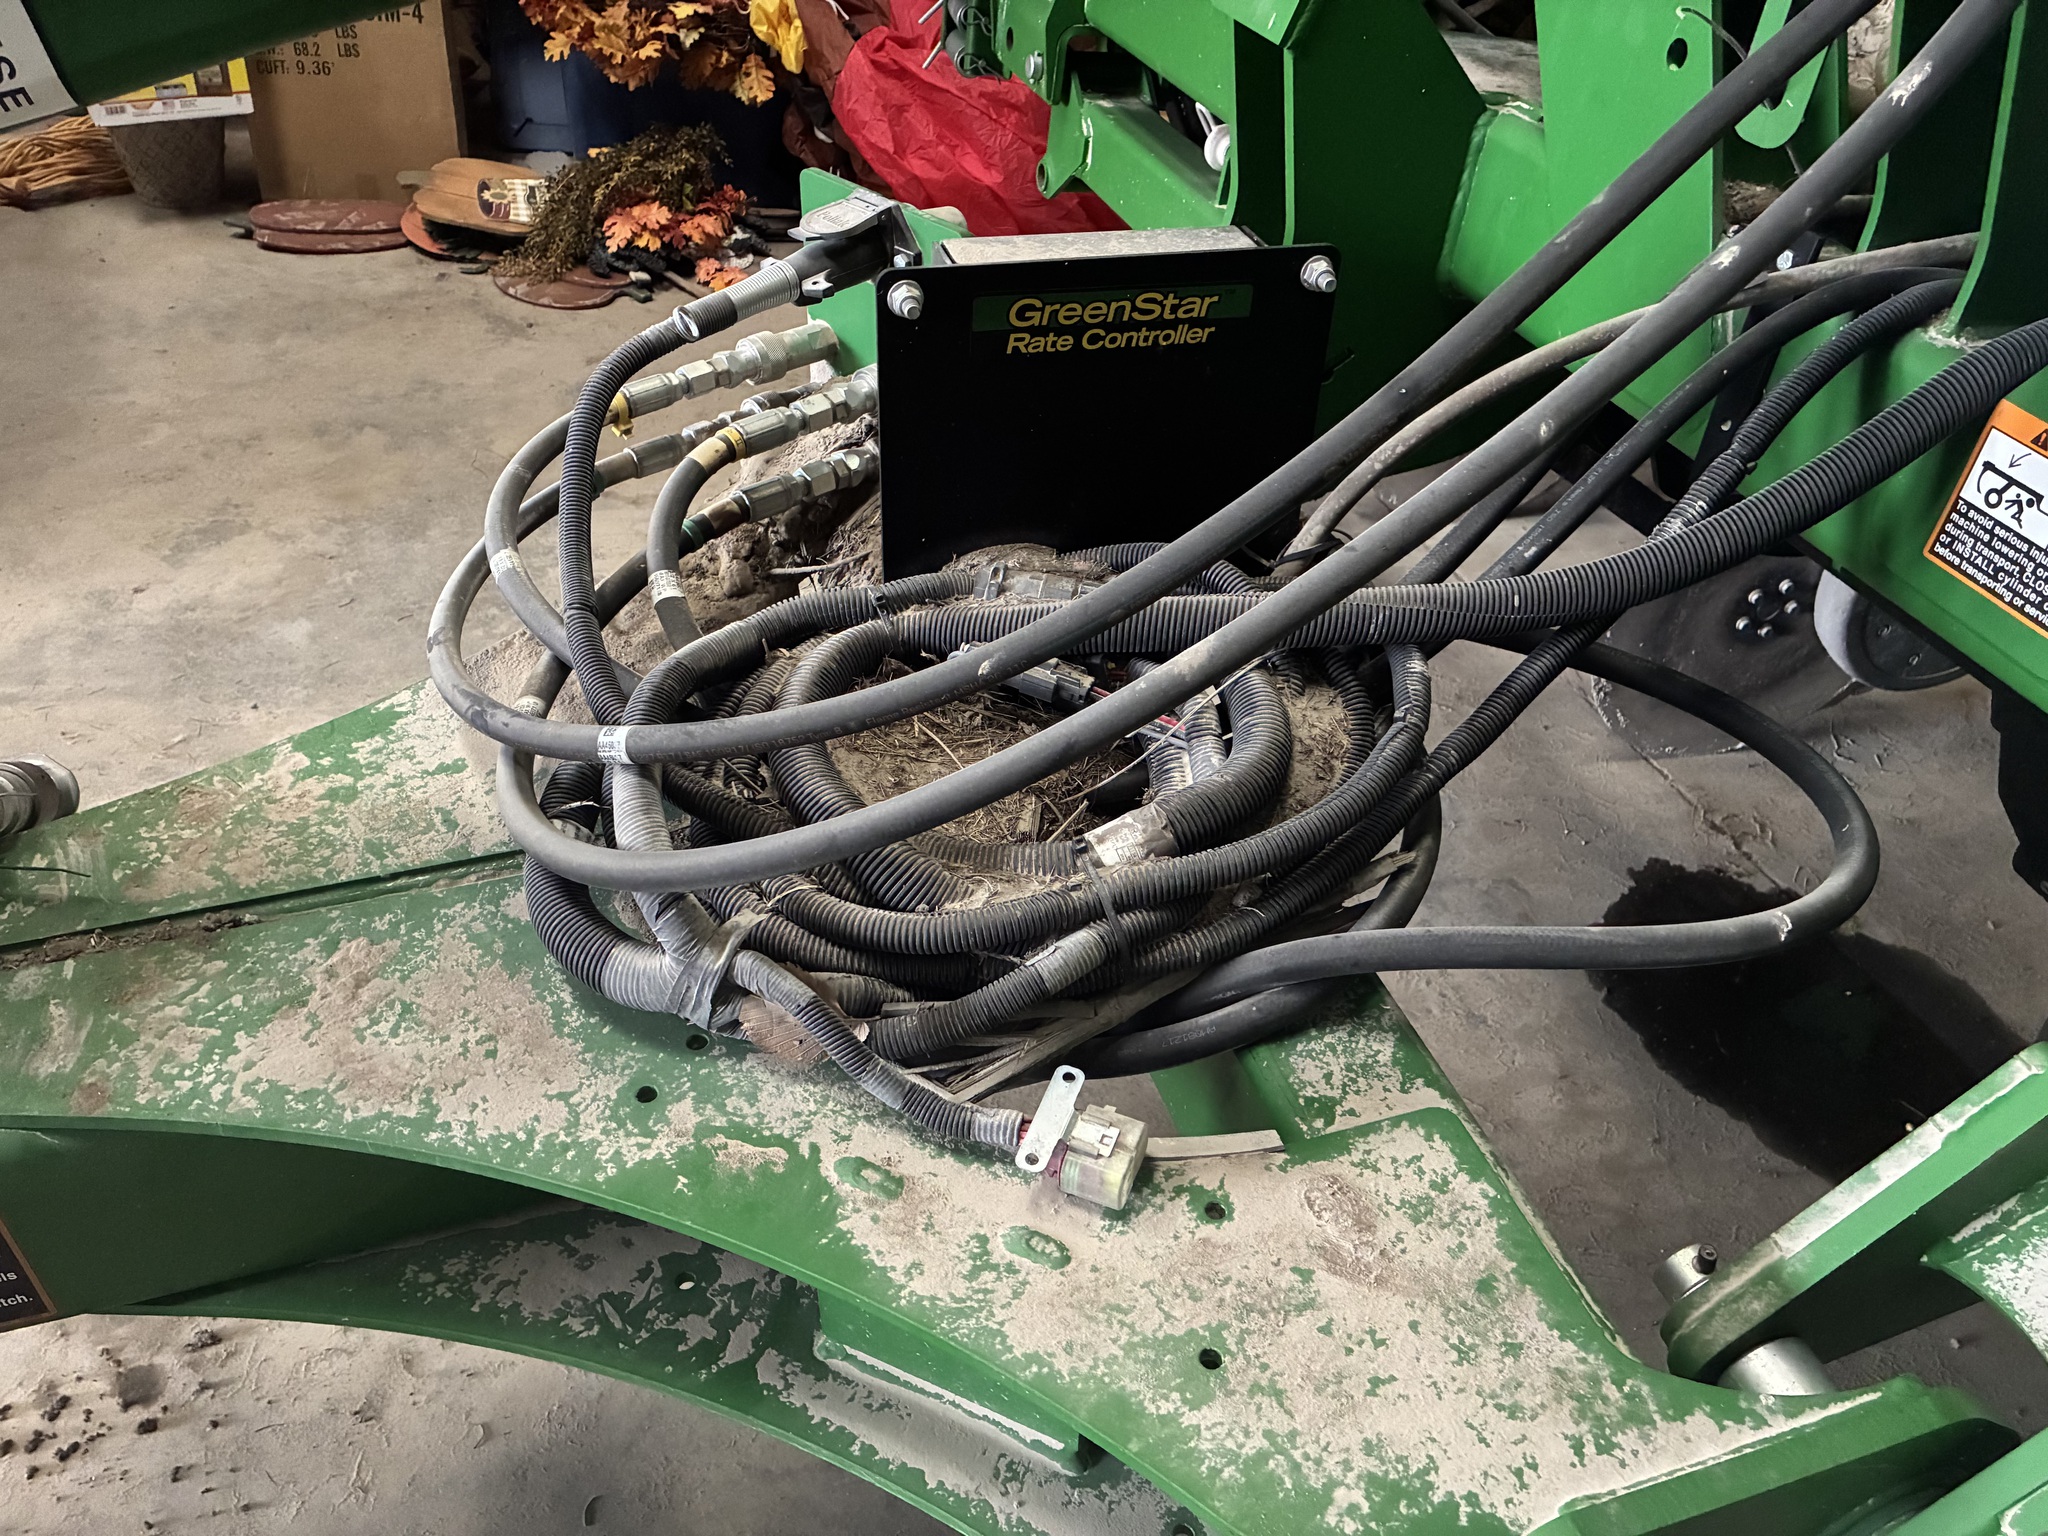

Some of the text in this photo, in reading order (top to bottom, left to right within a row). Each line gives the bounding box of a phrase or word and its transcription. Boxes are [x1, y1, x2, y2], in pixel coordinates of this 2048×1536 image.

[293, 41, 321, 57] 68.2
[337, 43, 361, 58] LBS
[335, 24, 358, 39] LBS
[1008, 292, 1219, 328] GreenStar
[1006, 324, 1216, 354] Rate Controller
[1944, 522, 1975, 548] during
[1975, 541, 2020, 579] transport,
[1950, 512, 2048, 579] machine lowering or
[1956, 499, 2048, 568] To avoid serious inju
[1934, 541, 1960, 566] before
[1960, 559, 2013, 602] transporting
[2012, 596, 2025, 607] or
[1939, 533, 2042, 604] or INSTALL cylinder
[0, 1271, 18, 1283] ls
[0, 1293, 34, 1309] tch.
